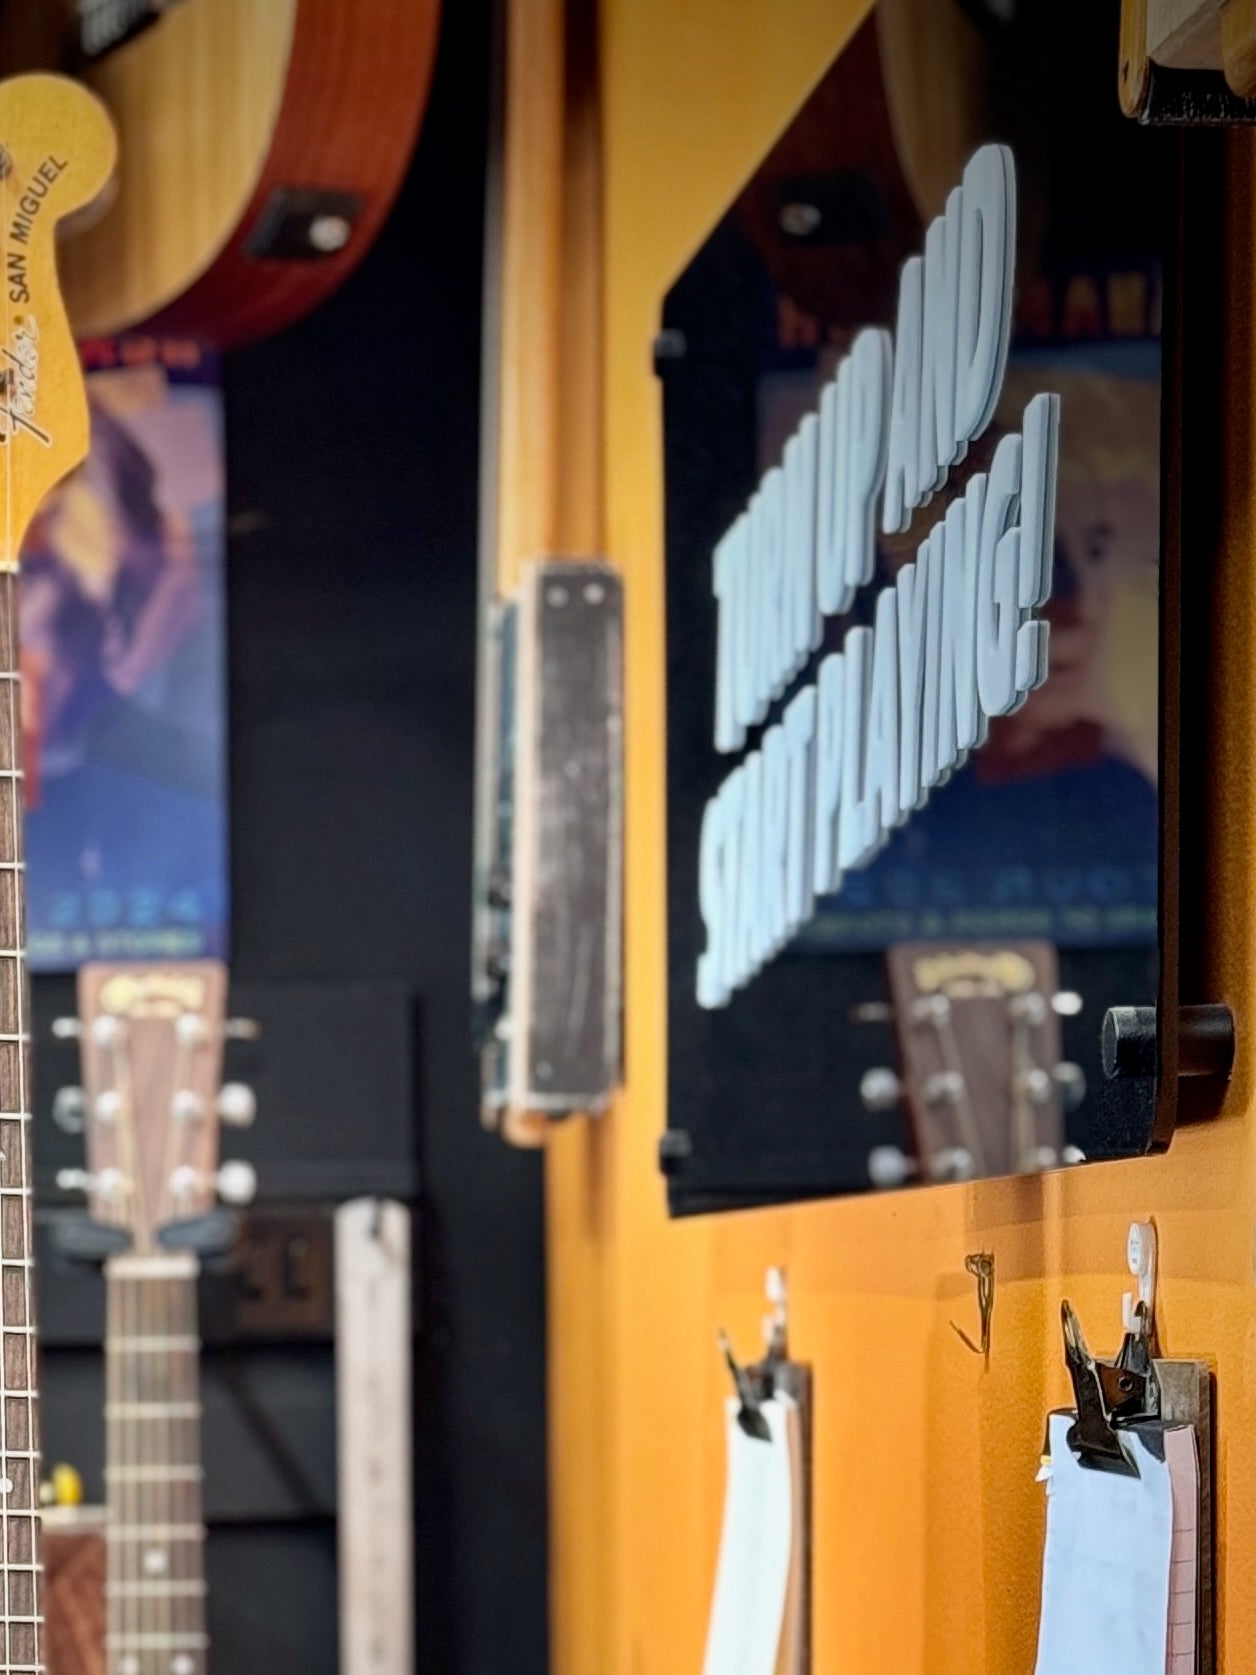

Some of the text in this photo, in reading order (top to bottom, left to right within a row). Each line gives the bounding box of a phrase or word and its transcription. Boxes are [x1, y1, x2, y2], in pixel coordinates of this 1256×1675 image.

[9, 153, 69, 304] SAN MIGUEL
[713, 143, 1017, 753] TURN UP AND
[696, 684, 817, 1009] START
[812, 393, 1061, 897] PLAYING!
